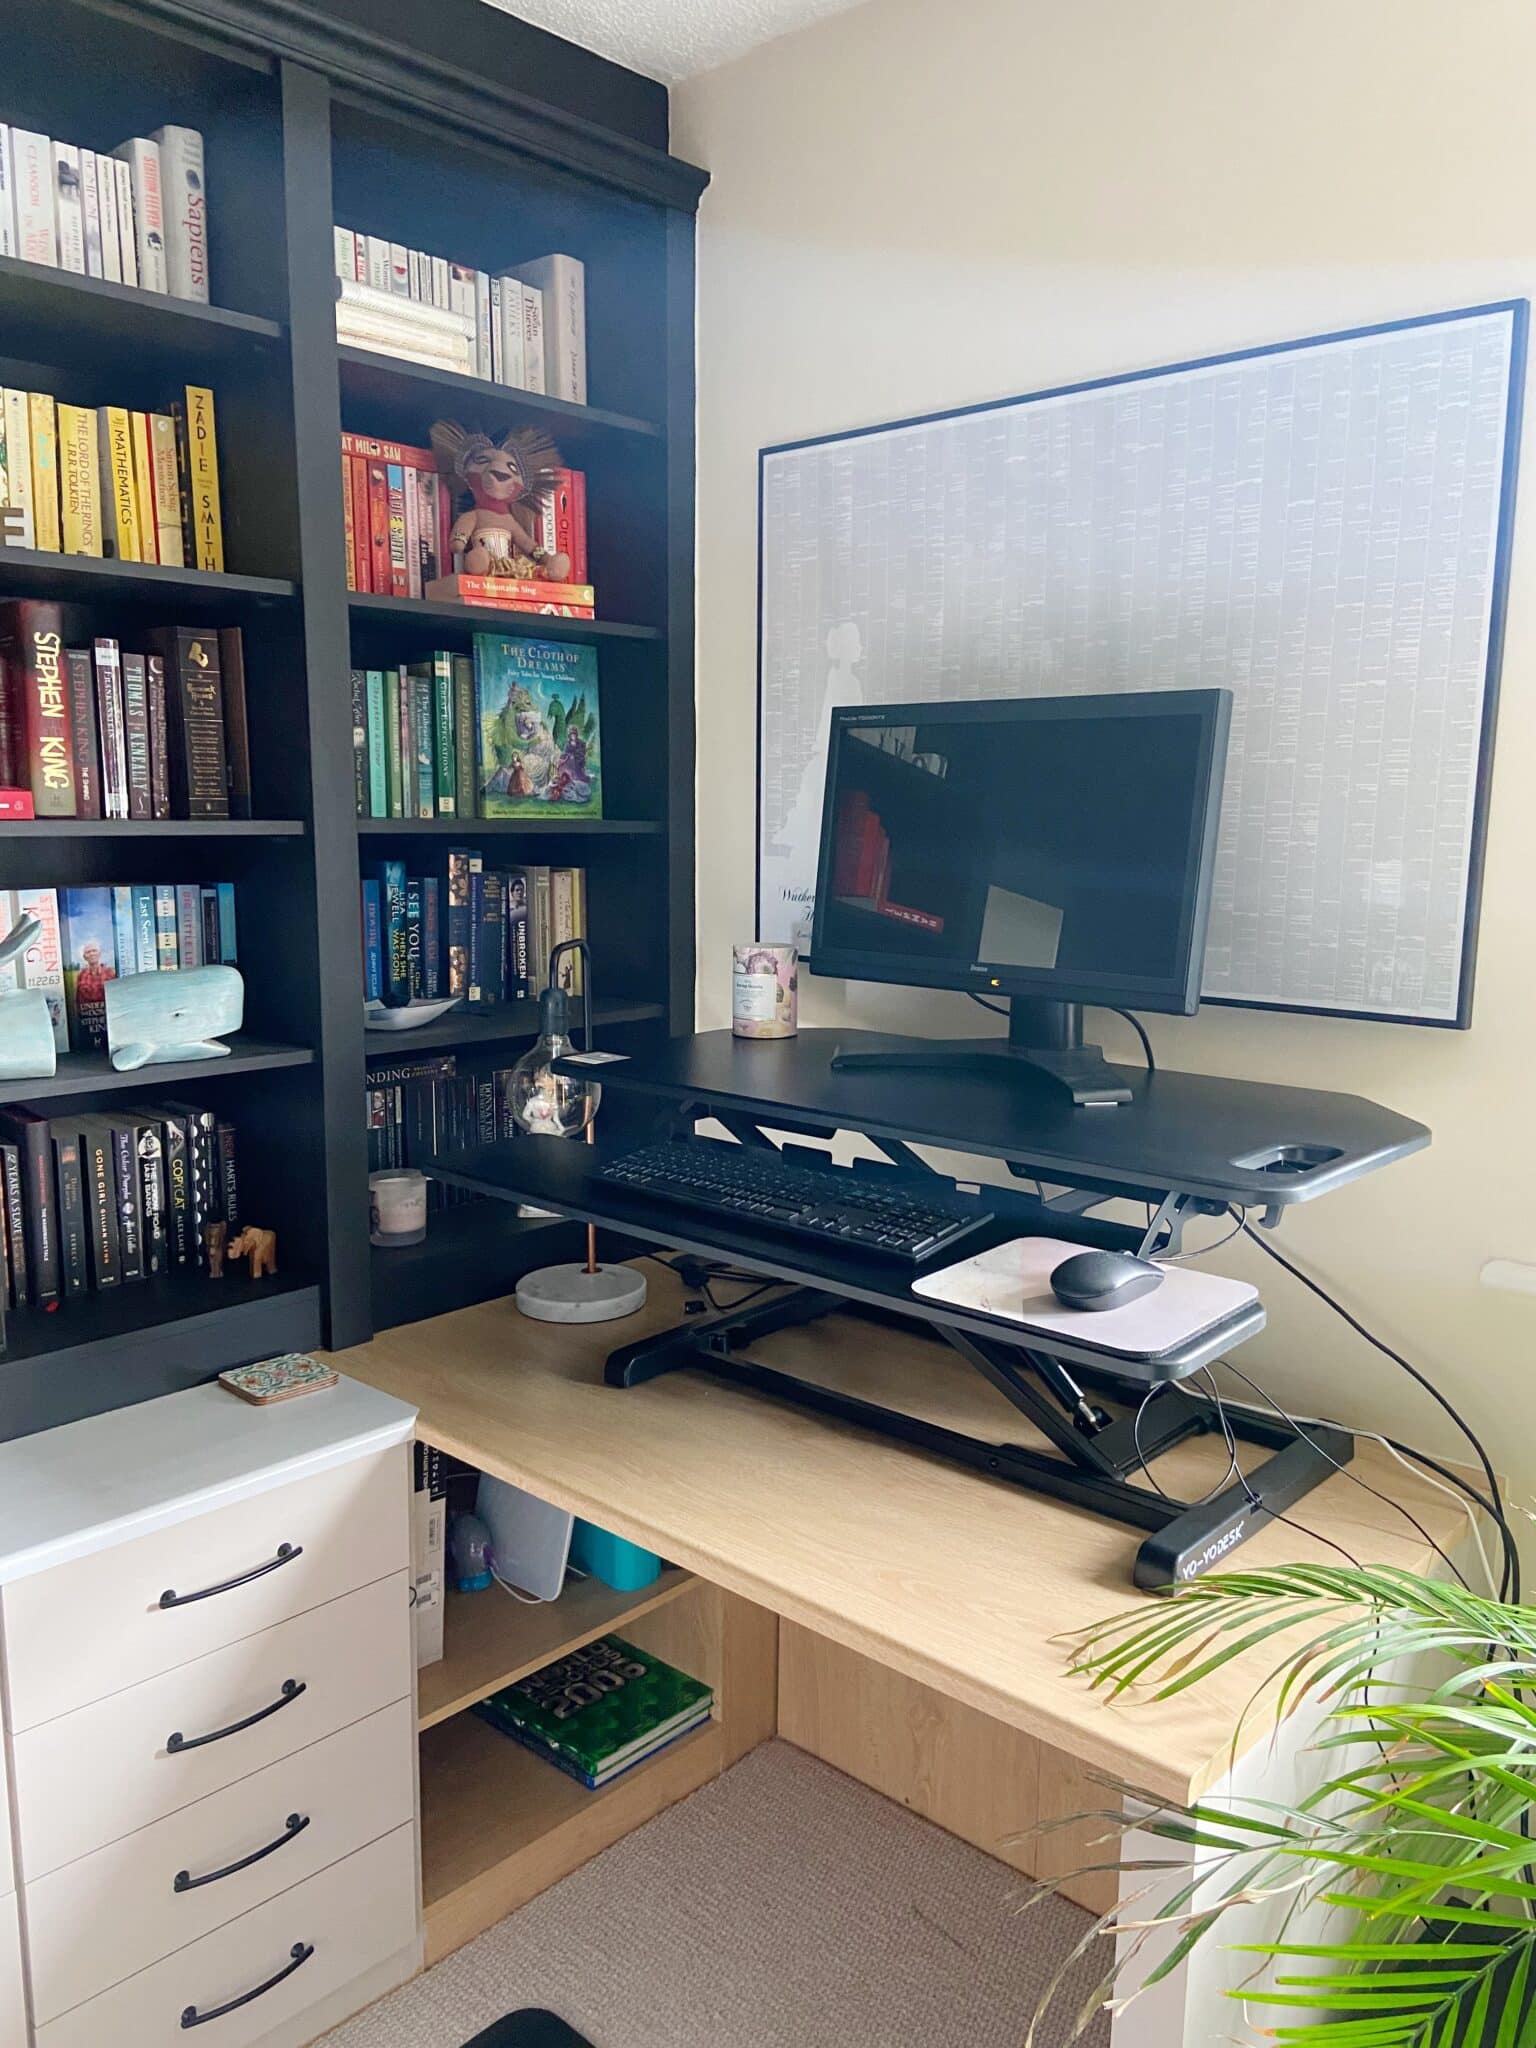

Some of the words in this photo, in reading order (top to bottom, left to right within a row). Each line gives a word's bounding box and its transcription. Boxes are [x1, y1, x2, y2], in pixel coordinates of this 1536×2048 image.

[144, 156, 157, 193] STATION
[145, 194, 160, 229] ELEVEN
[183, 193, 206, 286] Sapiens
[524, 296, 535, 342] Thieves
[531, 306, 540, 337] Swan
[77, 413, 88, 436] THE
[78, 437, 90, 468] LORD
[384, 444, 401, 461] SAW
[68, 470, 79, 515] TOLKIEN
[80, 470, 90, 488] OF
[114, 429, 132, 526] MATHEMATICS
[194, 395, 208, 472] ZADIE
[202, 496, 216, 571] SMITH
[81, 489, 91, 512] THE
[390, 487, 402, 522] ZADIE
[82, 512, 93, 547] RINGS
[392, 527, 404, 562] SMITH
[466, 580, 480, 589] The
[482, 581, 520, 593] Mountains
[520, 585, 536, 596] Sing
[502, 643, 525, 657] THE
[528, 646, 564, 662] CLOTH
[566, 654, 579, 664] OF
[517, 656, 566, 672] DREAMS
[34, 631, 64, 718] STEPHEN
[126, 666, 144, 716] THOMAS
[72, 663, 88, 724] STEPHEN
[104, 671, 115, 739] FRANKENSTEIN
[76, 727, 88, 763] KING
[440, 715, 449, 777] EXPECTATIONS
[39, 736, 69, 789] KING
[130, 733, 147, 791] KENEALLY
[140, 896, 151, 918] Last
[183, 891, 191, 909] BIG
[391, 883, 399, 922] JEWELL
[408, 893, 419, 918] SEE
[39, 894, 60, 972] STEPHEN
[141, 920, 151, 944] Seen
[183, 914, 192, 949] LITTLE
[409, 924, 419, 957] YOU
[184, 951, 193, 966] LIE
[518, 921, 526, 979] UNBROKEN
[392, 953, 401, 981] GONE
[119, 1134, 129, 1148] The
[95, 1149, 104, 1178] GONE
[226, 1160, 236, 1192] HART'S
[9, 1166, 21, 1195] YEARS
[97, 1182, 106, 1205] GIRL
[151, 1183, 159, 1211] CROW
[172, 1159, 184, 1210] COPYCAT
[11, 1206, 22, 1233] SLAVE
[100, 1208, 108, 1238] GILLIAN
[227, 1193, 237, 1221] RULES
[1182, 1520, 1245, 1580] YO-YODESK
